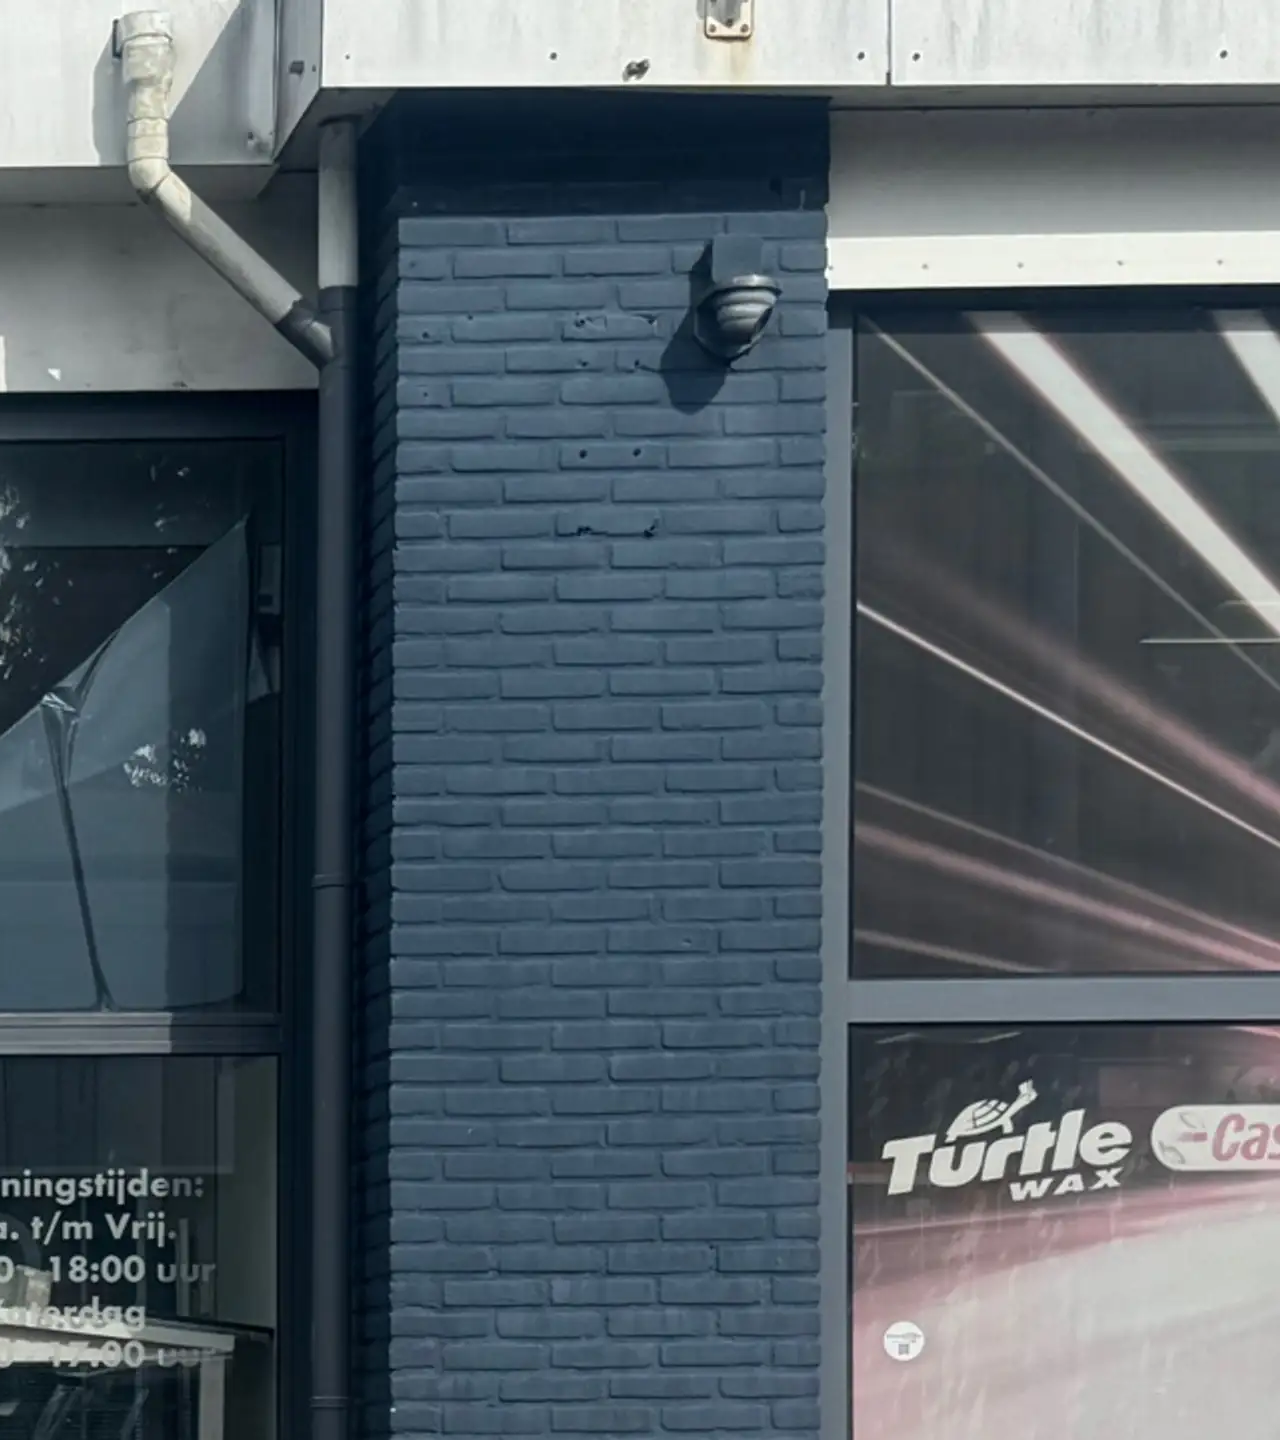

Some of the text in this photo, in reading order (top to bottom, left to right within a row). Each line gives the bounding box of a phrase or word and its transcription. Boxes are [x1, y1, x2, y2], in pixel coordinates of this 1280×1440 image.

[881, 1108, 1133, 1196] Turtle
[1009, 1167, 1124, 1202] WAX
[31, 1210, 93, 1246] t/m
[104, 1211, 177, 1248] Vrij.
[49, 1255, 146, 1284] 18:00
[157, 1263, 217, 1283] uur
